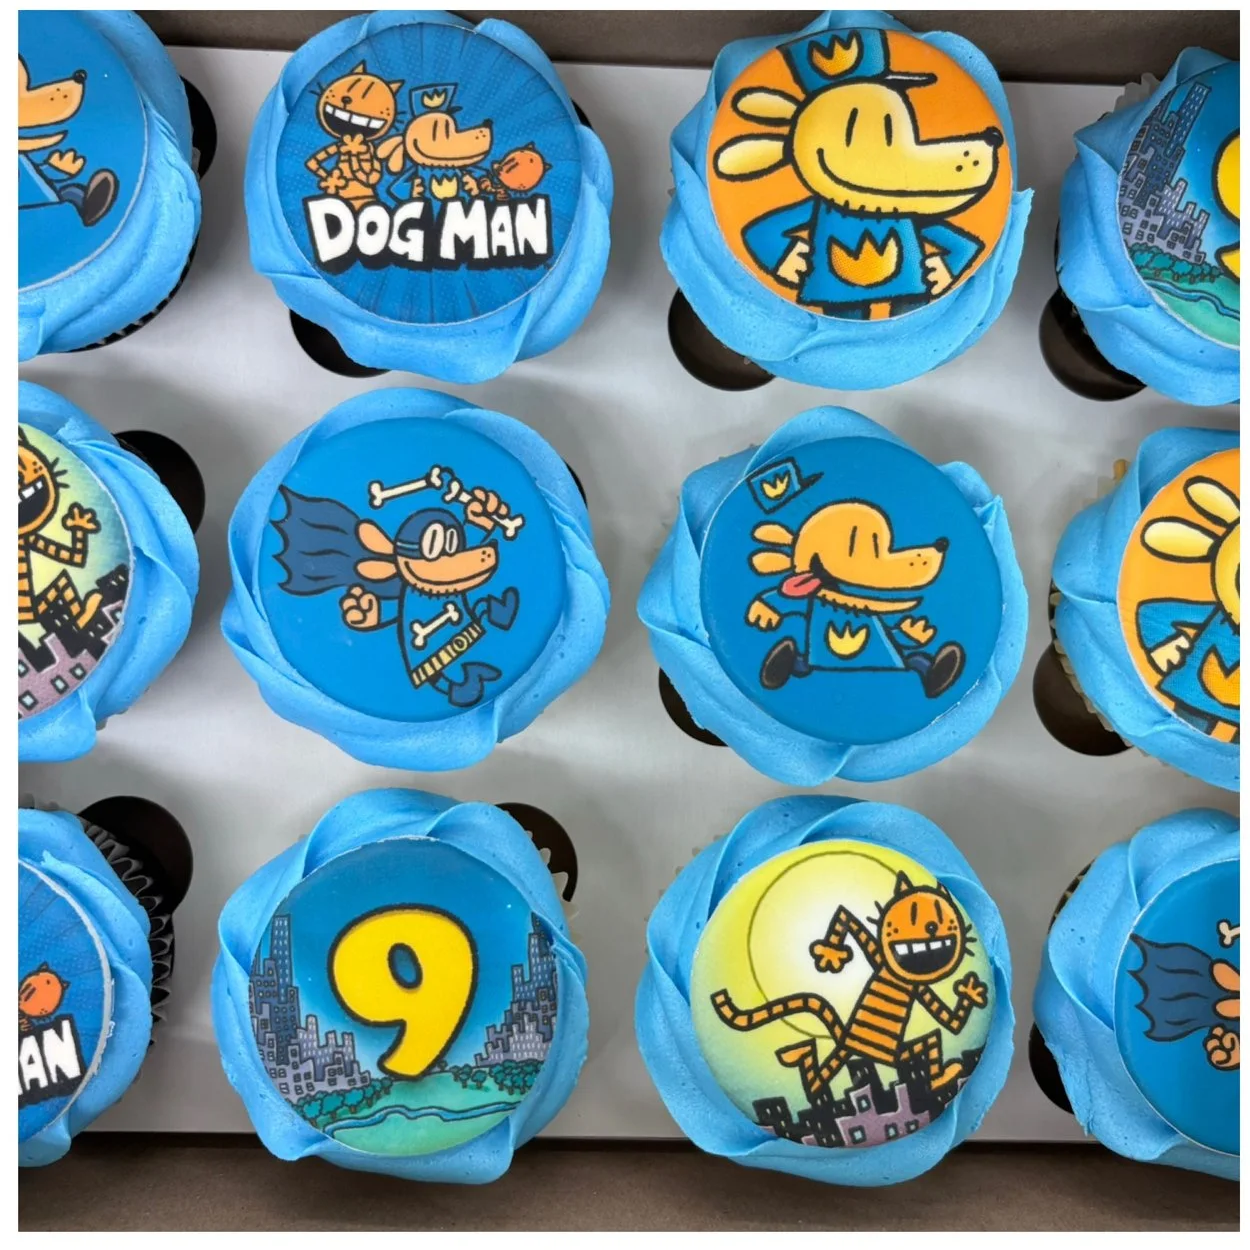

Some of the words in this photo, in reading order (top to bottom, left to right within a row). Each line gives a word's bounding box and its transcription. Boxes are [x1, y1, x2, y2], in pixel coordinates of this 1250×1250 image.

[307, 198, 425, 262] DOG
[439, 198, 548, 260] MAN
[327, 903, 479, 1081] 9
[18, 1018, 81, 1095] AN
